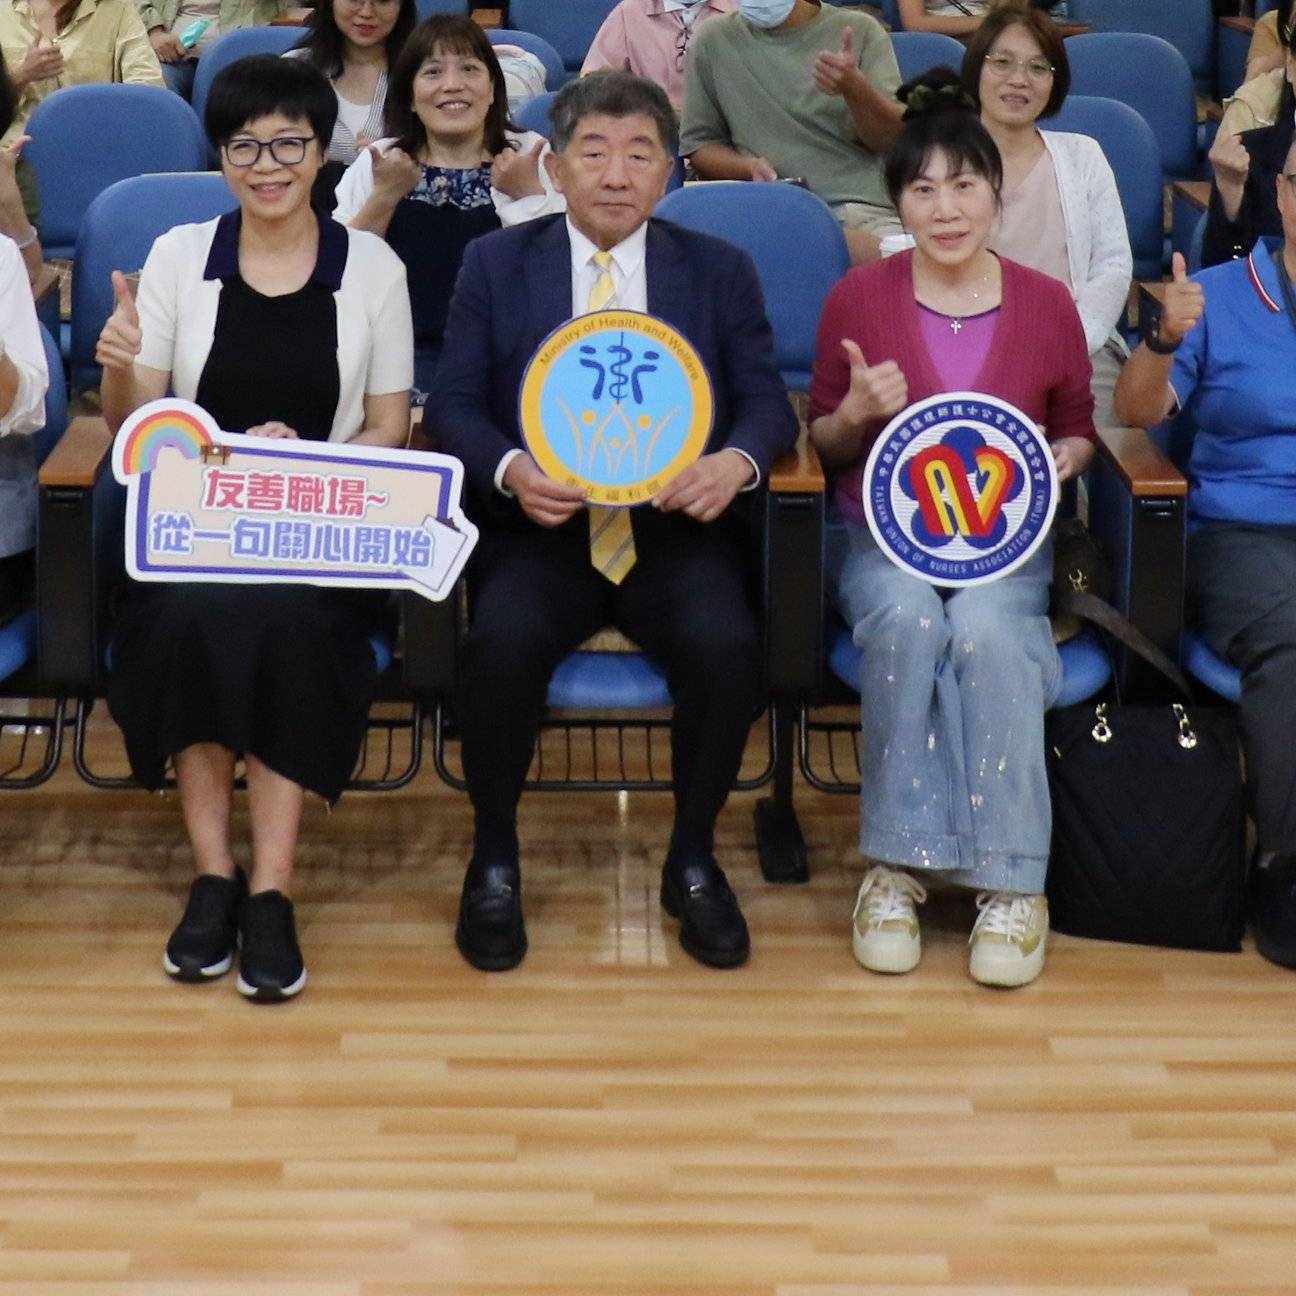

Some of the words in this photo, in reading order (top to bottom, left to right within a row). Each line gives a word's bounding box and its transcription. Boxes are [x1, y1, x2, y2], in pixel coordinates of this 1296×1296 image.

[540, 328, 580, 366] Ministry
[583, 316, 596, 331] of
[599, 317, 640, 330] Health
[643, 322, 665, 341] and
[667, 334, 699, 381] Welfare
[150, 512, 433, 568] 從一句關心開始
[912, 552, 925, 564] OF
[929, 560, 968, 575] NURSES
[973, 529, 1032, 572] ASSOCIATION
